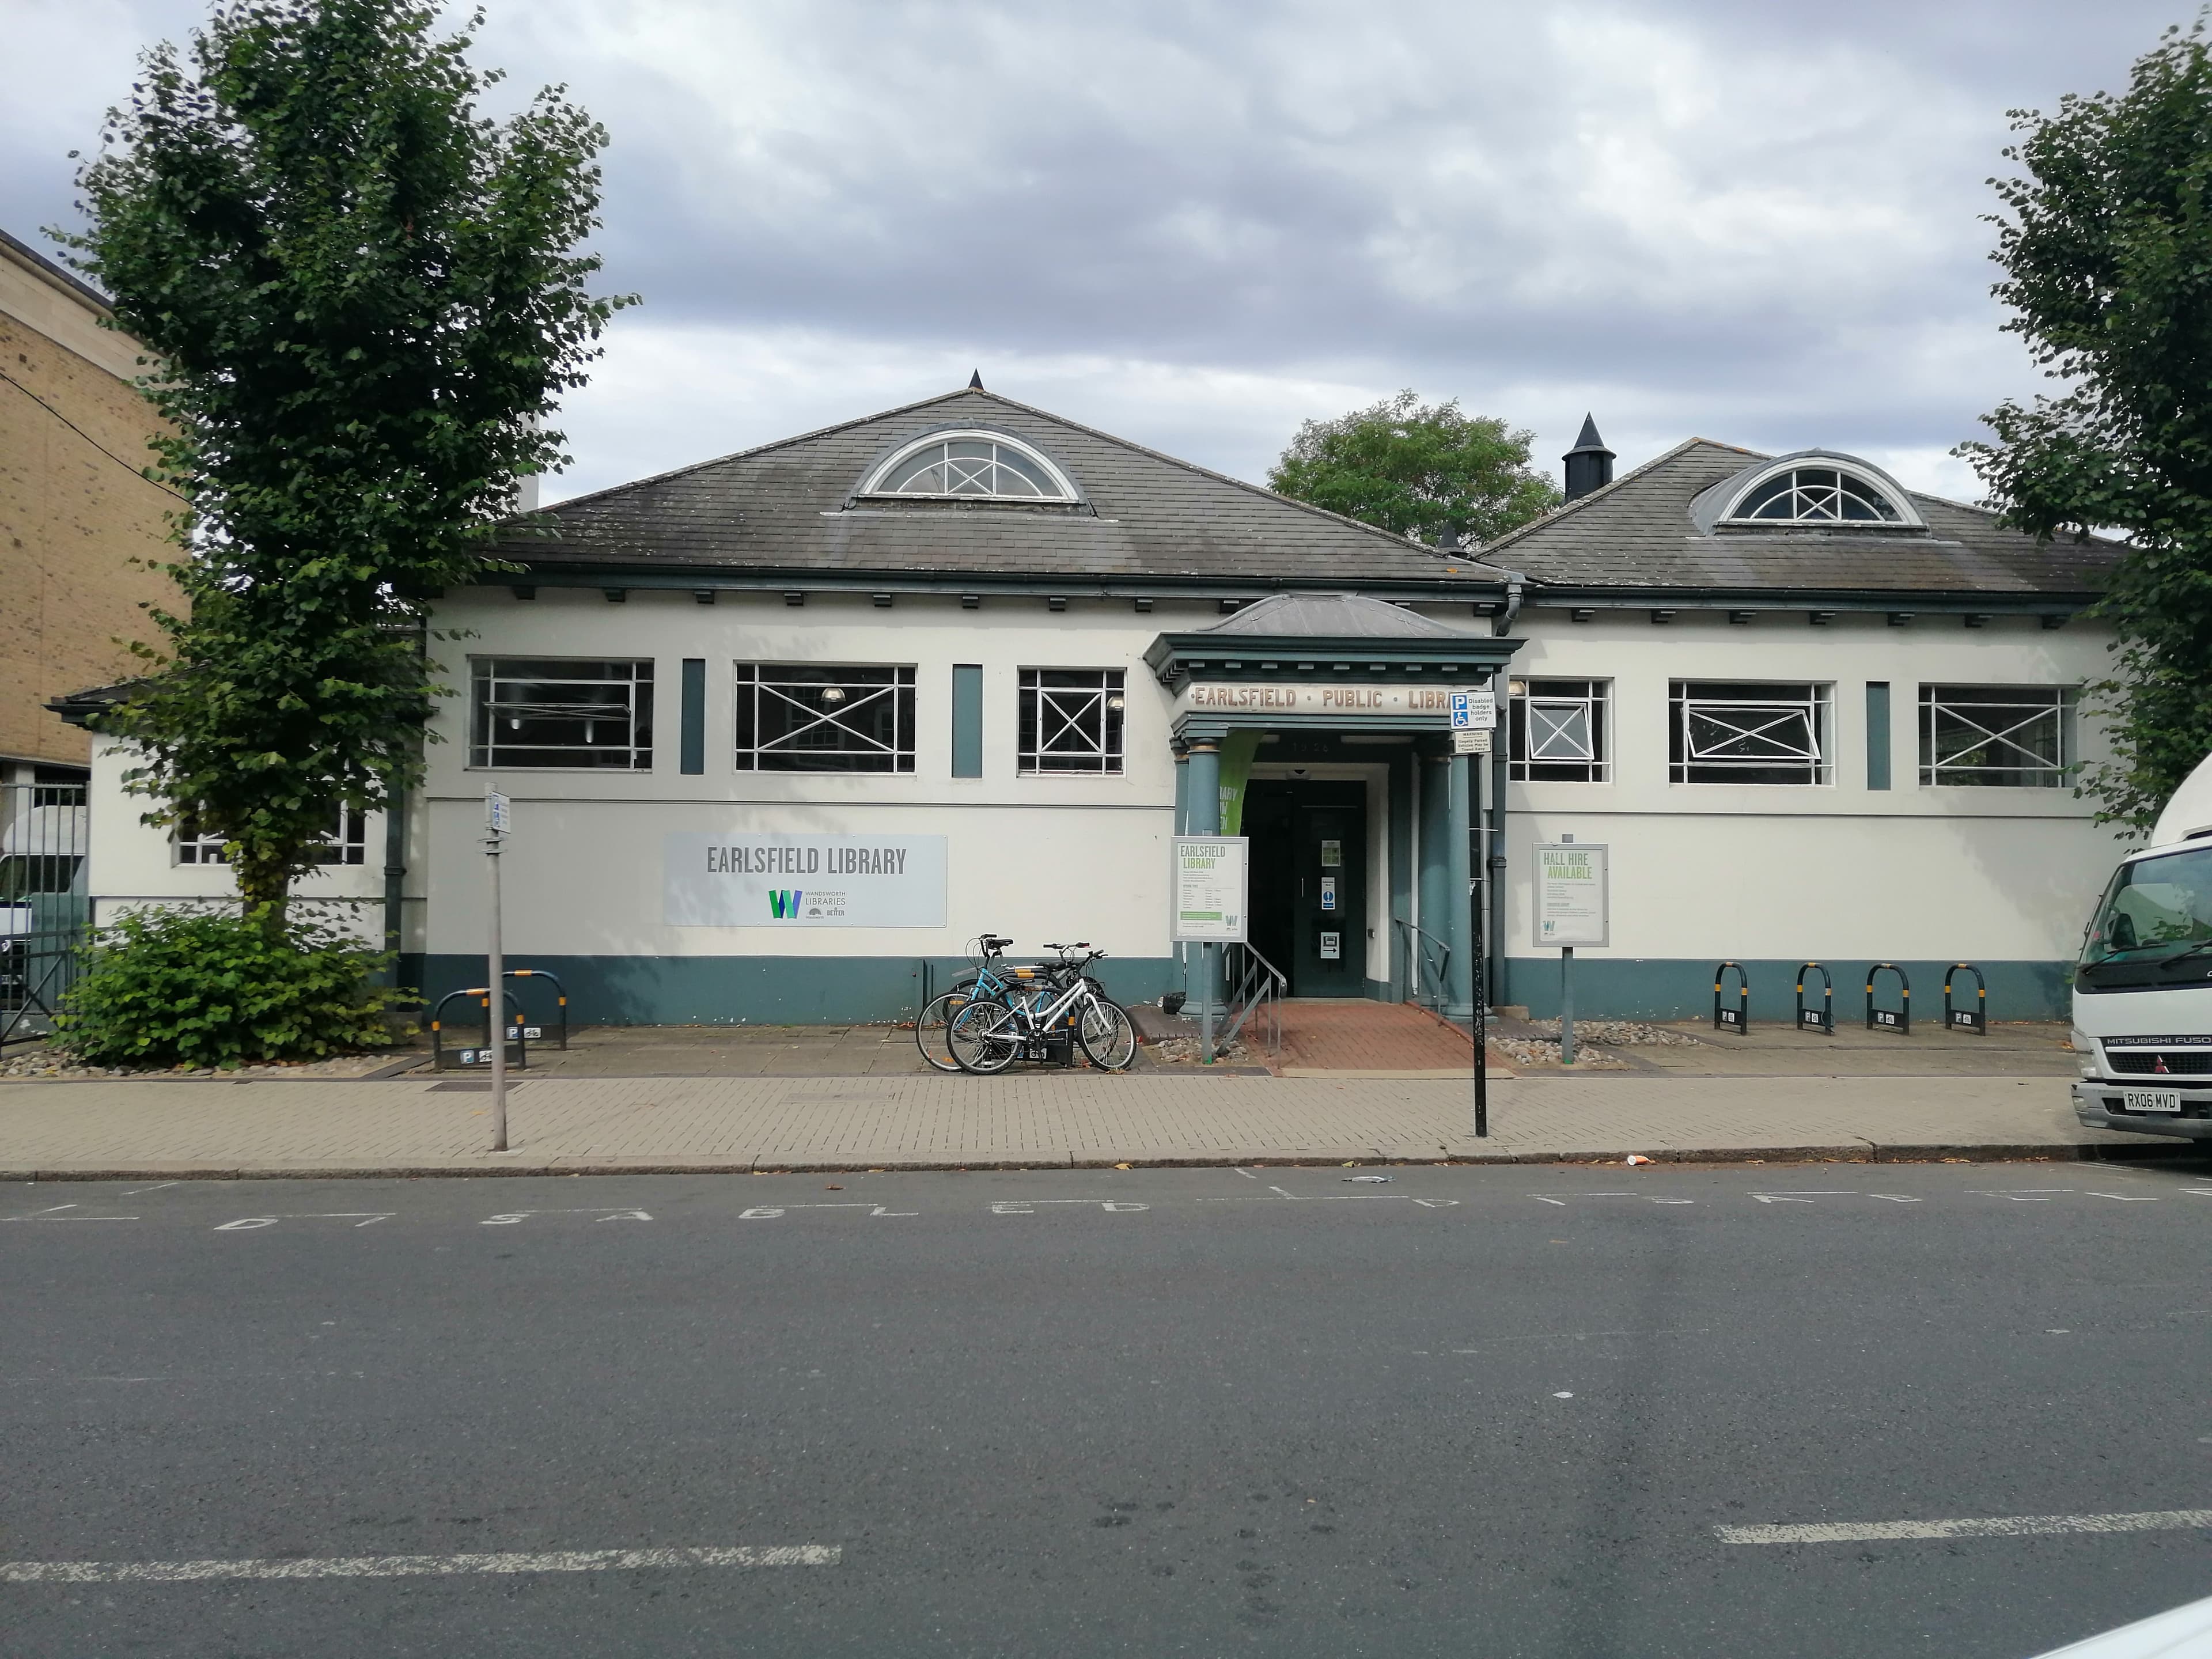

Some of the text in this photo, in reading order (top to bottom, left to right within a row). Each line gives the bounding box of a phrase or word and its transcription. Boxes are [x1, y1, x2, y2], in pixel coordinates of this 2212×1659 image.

[1195, 687, 1450, 709] EARLSFIELD PUBLIC LIBR
[1455, 696, 1466, 709] P
[1180, 846, 1226, 858] EARLSFIELD
[707, 847, 907, 874] EARLSFIELD LIBRARY
[1183, 858, 1216, 869] LIBRARY
[1543, 853, 1588, 866] HALL HIRE
[1547, 866, 1593, 880] AVAILABLE
[805, 897, 846, 906] LIBRARIES
[827, 907, 845, 916] BETTER
[2127, 1093, 2176, 1109] RX06 MVD
